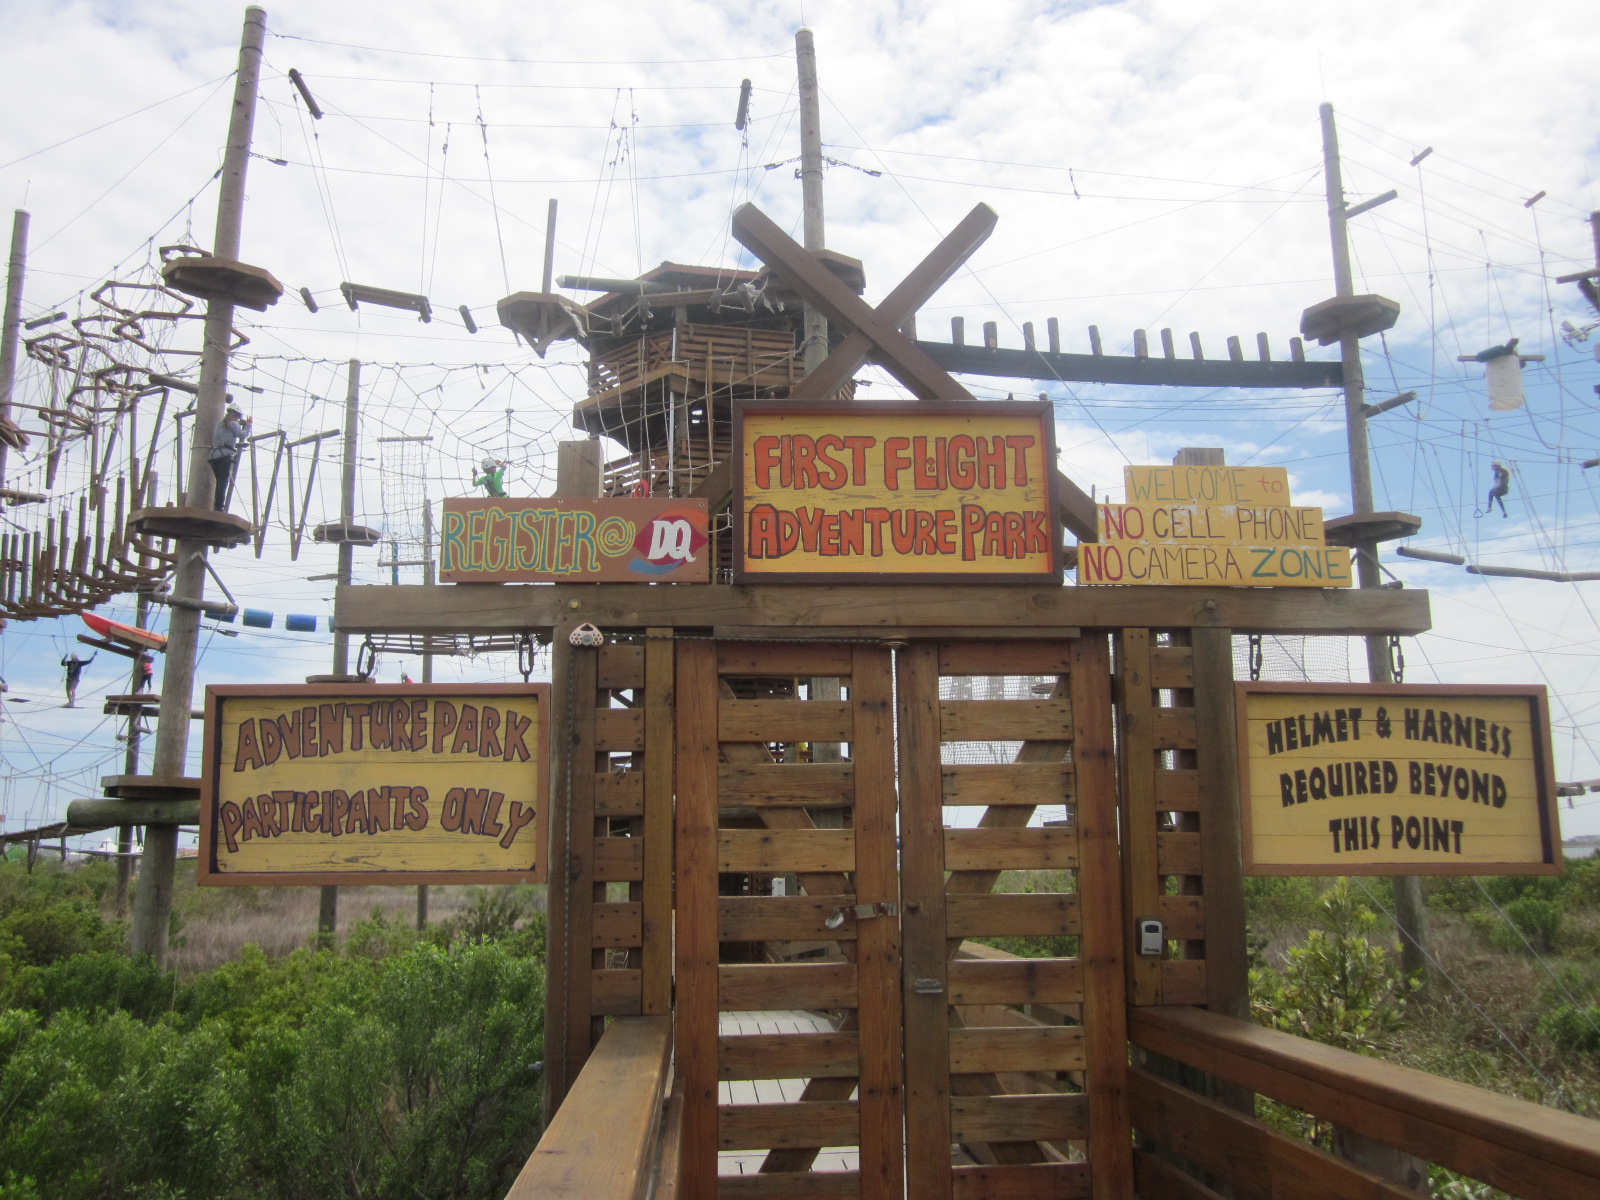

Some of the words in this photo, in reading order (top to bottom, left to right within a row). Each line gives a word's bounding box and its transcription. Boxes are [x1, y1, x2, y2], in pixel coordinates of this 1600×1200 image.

[754, 434, 876, 490] FIRST
[884, 434, 1035, 491] FLIGHT
[1129, 468, 1252, 502] WELCOME
[1258, 474, 1283, 493] to
[440, 506, 601, 574] REGISTER
[597, 517, 635, 557] @
[647, 519, 696, 563] DQ
[748, 503, 957, 559] ADVENTURE
[961, 504, 1048, 561] PARK
[1103, 506, 1144, 540] NO
[1152, 507, 1225, 539] CELL
[1236, 508, 1319, 540] PHONE
[1083, 545, 1123, 581] NO
[1128, 547, 1243, 581] CAMERA
[1250, 549, 1347, 579] ZONE
[233, 699, 428, 772] ADVENTURE
[432, 700, 532, 762] PARK
[1265, 707, 1362, 755] HELMET
[1376, 706, 1392, 739] &
[1404, 708, 1512, 758] HARNESS
[1279, 760, 1398, 808] REQUIRED
[1408, 761, 1507, 809] BEYOND
[220, 786, 429, 853] PARTICIPANTS
[440, 787, 537, 849] ONLY
[1328, 816, 1380, 853] THIS
[1391, 815, 1464, 854] POINT
